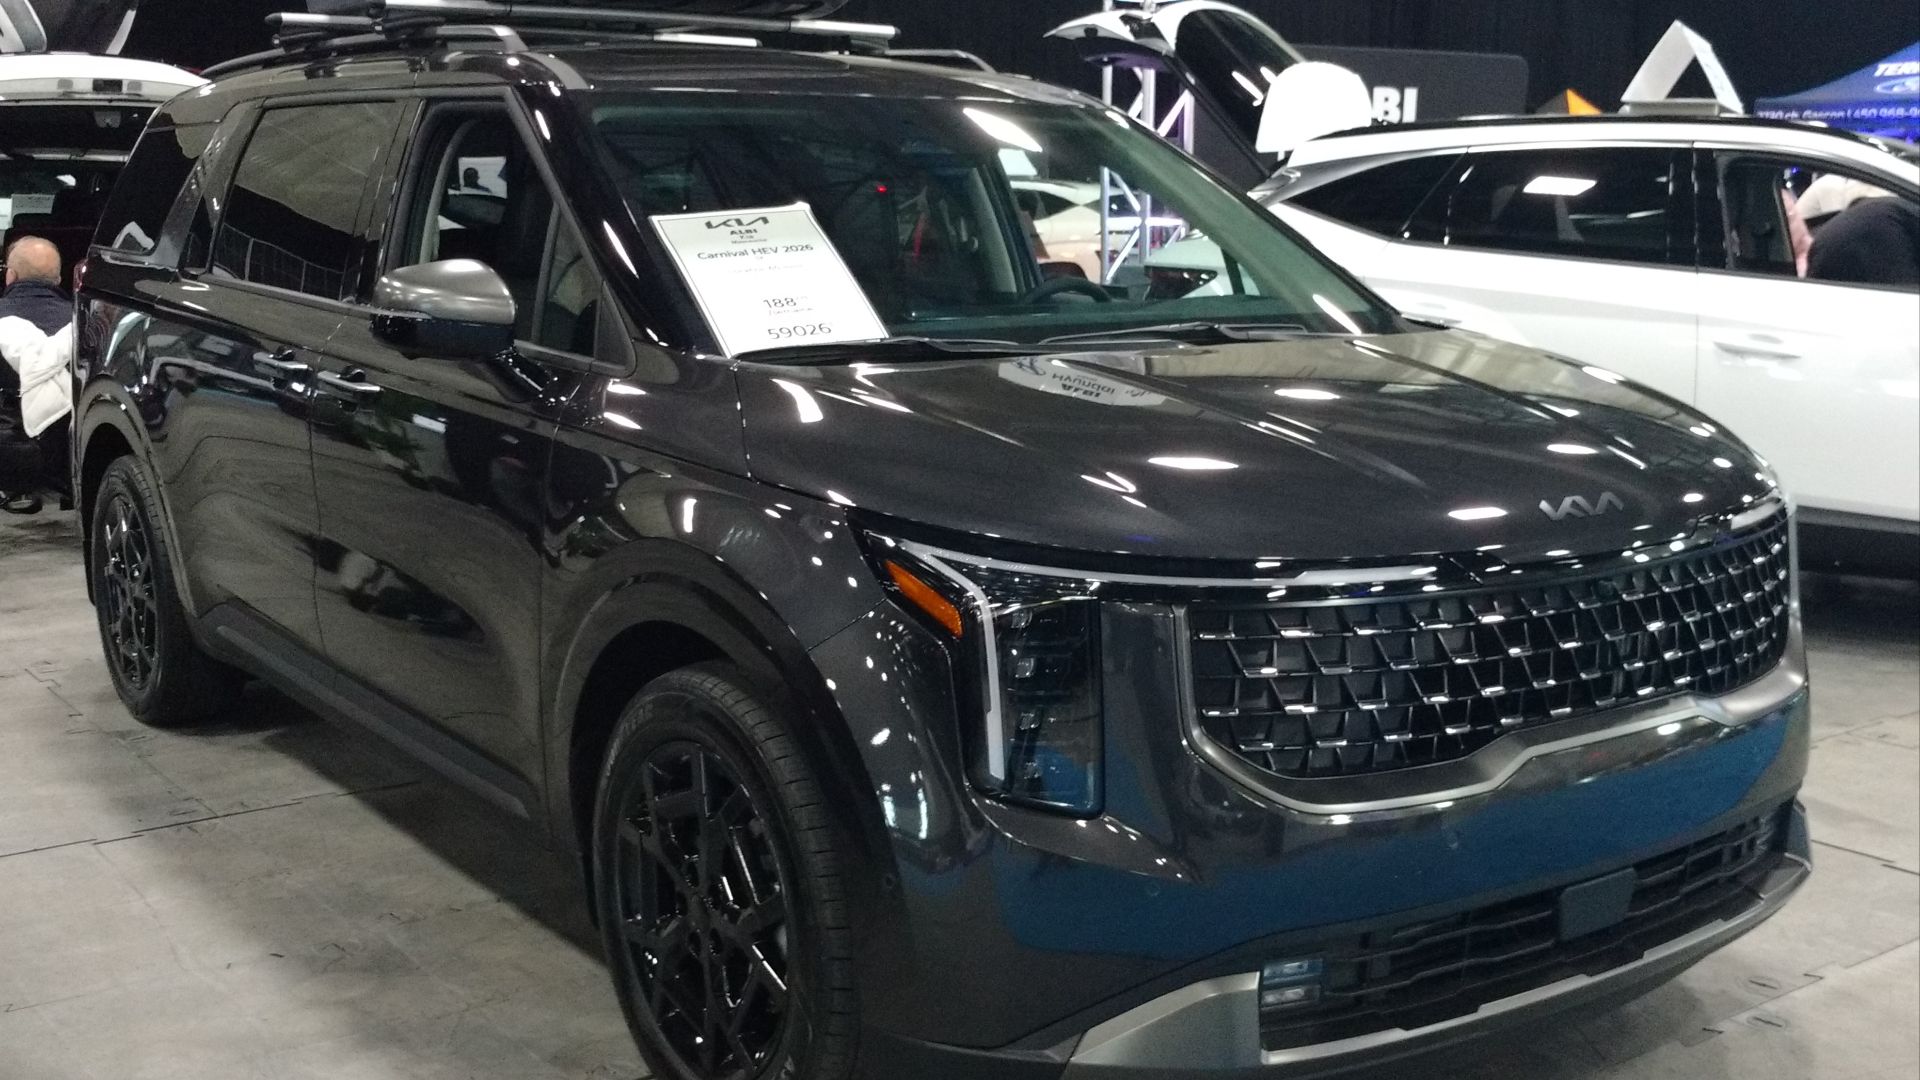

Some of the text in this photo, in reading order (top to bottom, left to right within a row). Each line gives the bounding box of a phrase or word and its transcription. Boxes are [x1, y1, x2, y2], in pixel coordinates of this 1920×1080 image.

[1874, 61, 1919, 76] TER
[1373, 87, 1418, 124] BI
[705, 216, 769, 229] KIA
[697, 250, 748, 260] Carnival
[751, 247, 778, 255] HEV
[782, 244, 814, 253] 2026
[763, 297, 797, 308] 188
[768, 323, 832, 340] 59026
[1538, 491, 1624, 520] KIA
